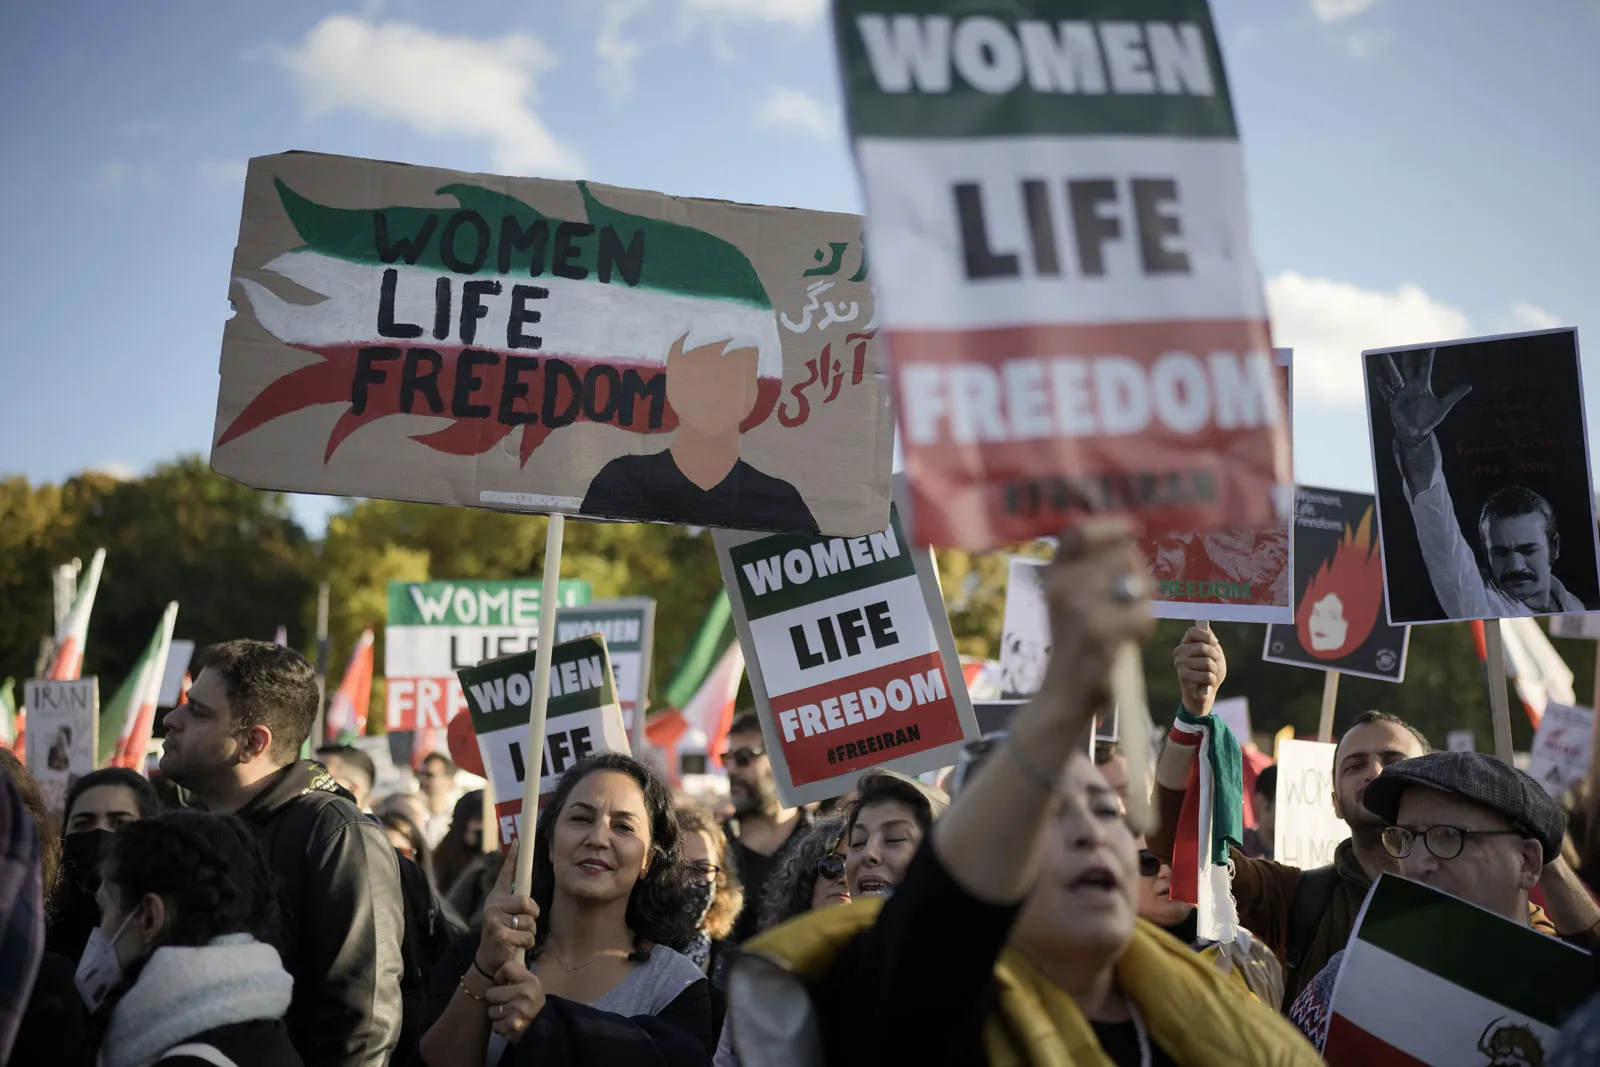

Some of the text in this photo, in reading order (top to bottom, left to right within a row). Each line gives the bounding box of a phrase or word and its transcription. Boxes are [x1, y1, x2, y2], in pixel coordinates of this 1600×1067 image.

[855, 12, 1215, 97] WOMEN
[373, 209, 645, 286] WOMEN
[951, 177, 1192, 280] LIFE
[377, 268, 549, 350] LIFE
[351, 347, 667, 430] FREEDOM
[904, 350, 1278, 447] FREEDOM
[741, 523, 901, 597] WOMEN
[789, 600, 899, 671] LIFE
[34, 684, 87, 710] IRAN
[778, 668, 948, 743] FREEDOM
[827, 724, 921, 765] #FREEIRAN
[1284, 767, 1335, 805] WOM
